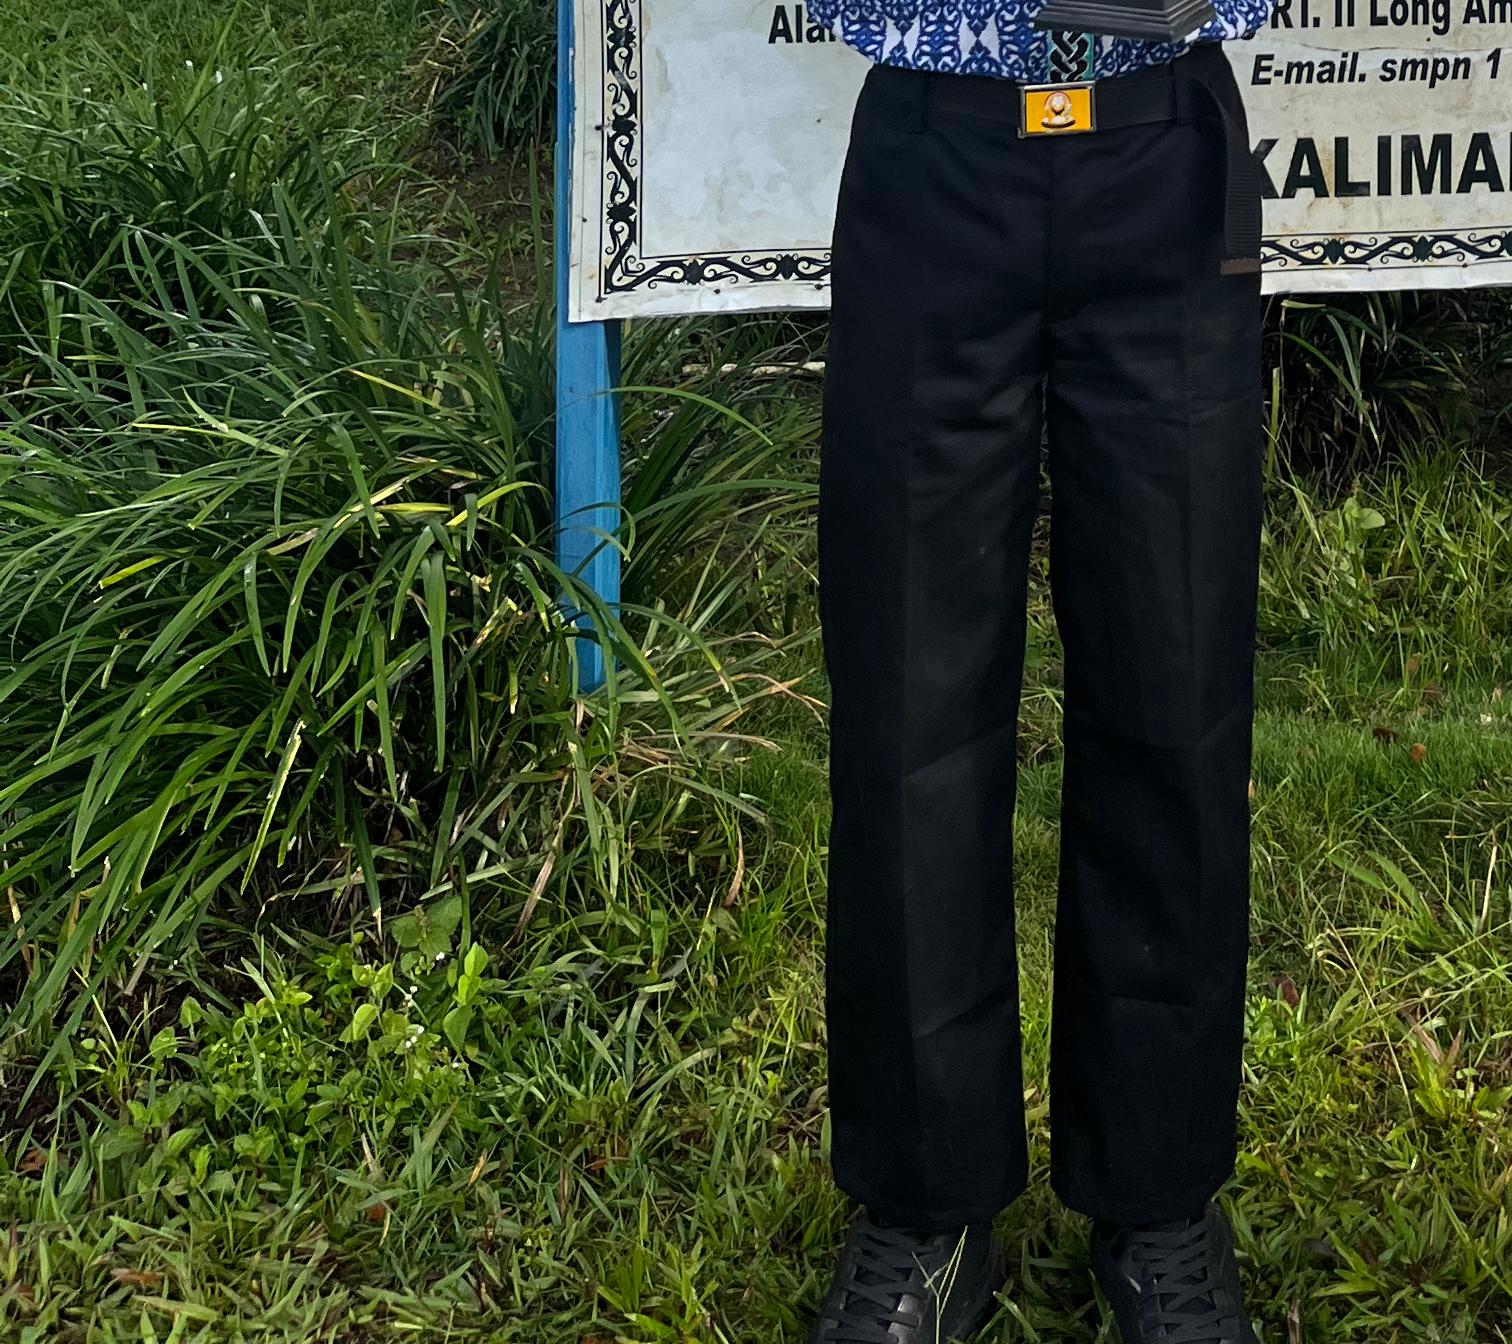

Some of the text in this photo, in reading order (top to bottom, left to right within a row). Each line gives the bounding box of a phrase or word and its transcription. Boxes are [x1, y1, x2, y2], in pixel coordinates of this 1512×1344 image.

[1250, 51, 1368, 87] E-mail.
[1378, 55, 1473, 89] smpn
[1485, 48, 1503, 79] 1
